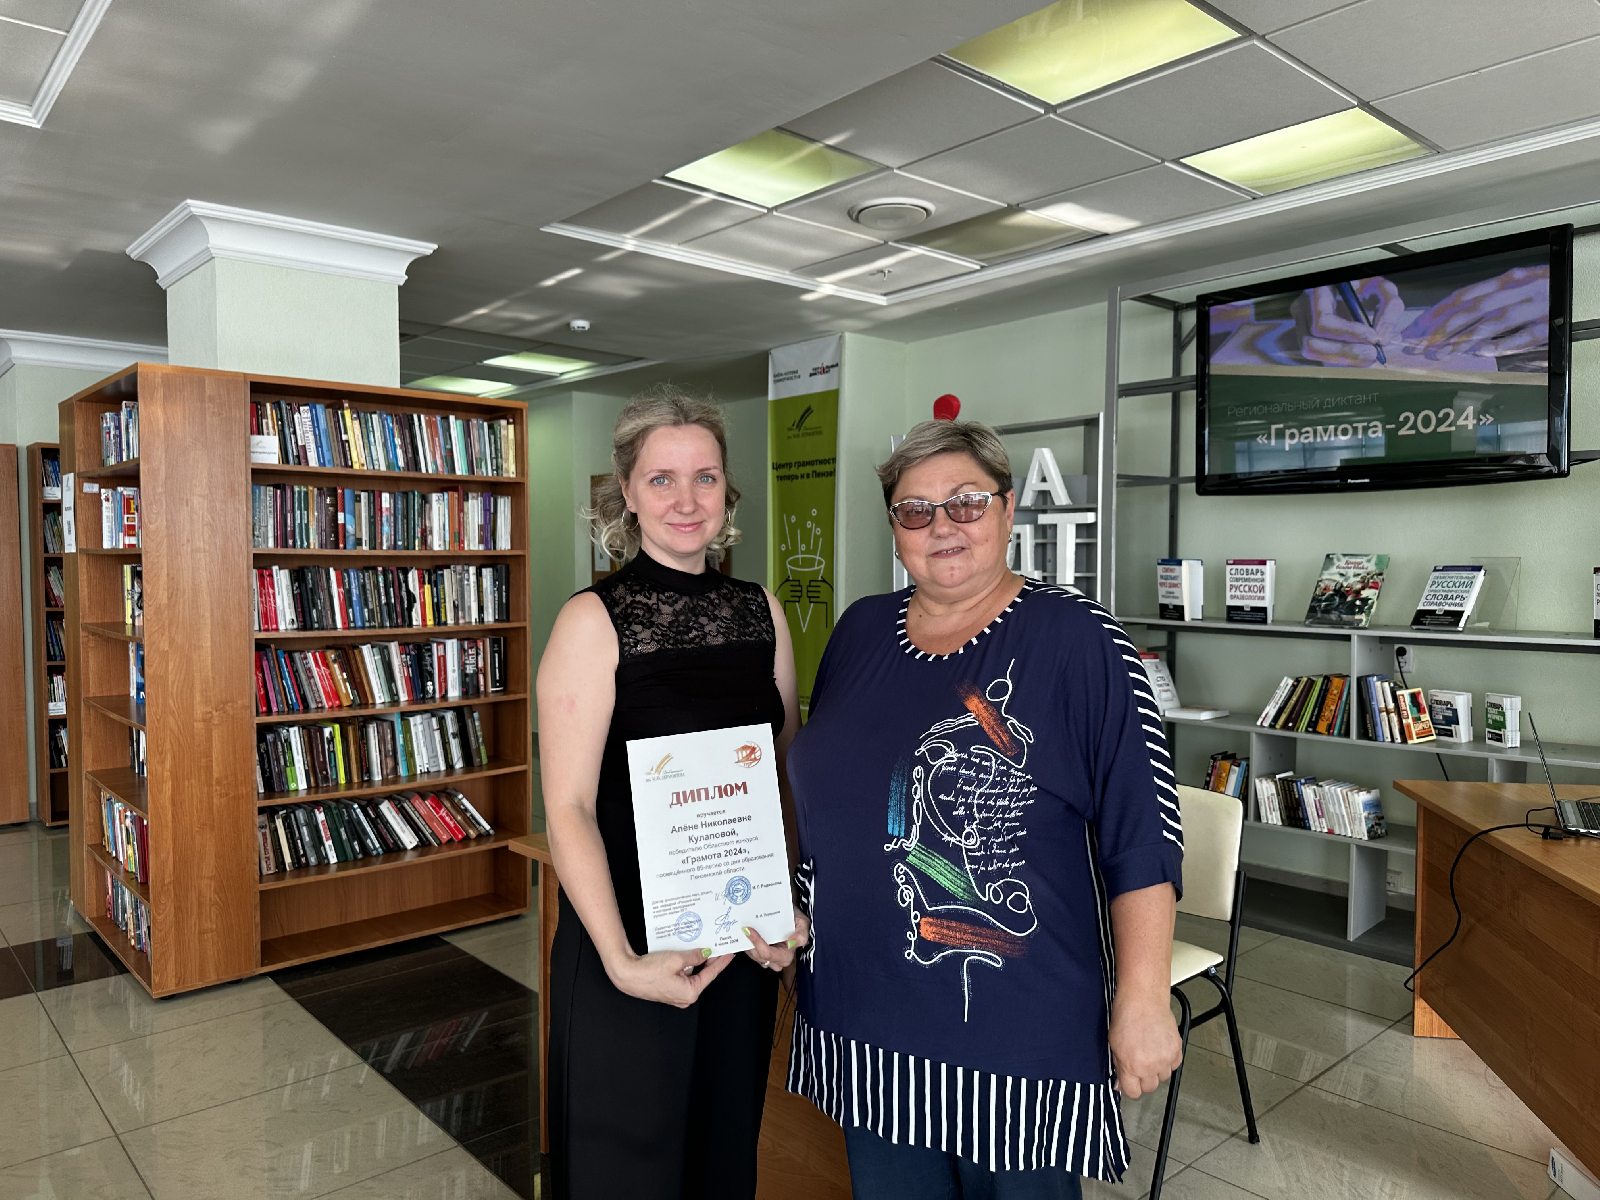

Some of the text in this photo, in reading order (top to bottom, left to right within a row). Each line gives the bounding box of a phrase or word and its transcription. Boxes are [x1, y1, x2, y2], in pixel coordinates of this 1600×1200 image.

[1228, 392, 1379, 418] Региональный диктант
[1256, 405, 1494, 451] «Грамота-2024»
[772, 461, 794, 472] Центр
[776, 474, 800, 482] теперь
[812, 468, 836, 478] Пензе!
[1229, 568, 1265, 576] СЛОВАРЬ
[1229, 584, 1265, 594] РУССКОЙ
[1430, 580, 1474, 588] РУССКИЙ
[669, 782, 748, 808] ДИПЛОМ
[670, 814, 752, 834] Алёне Николаевне
[688, 828, 738, 844] Кулаповой,
[682, 852, 722, 865] «Грамота
[724, 866, 745, 875] области
